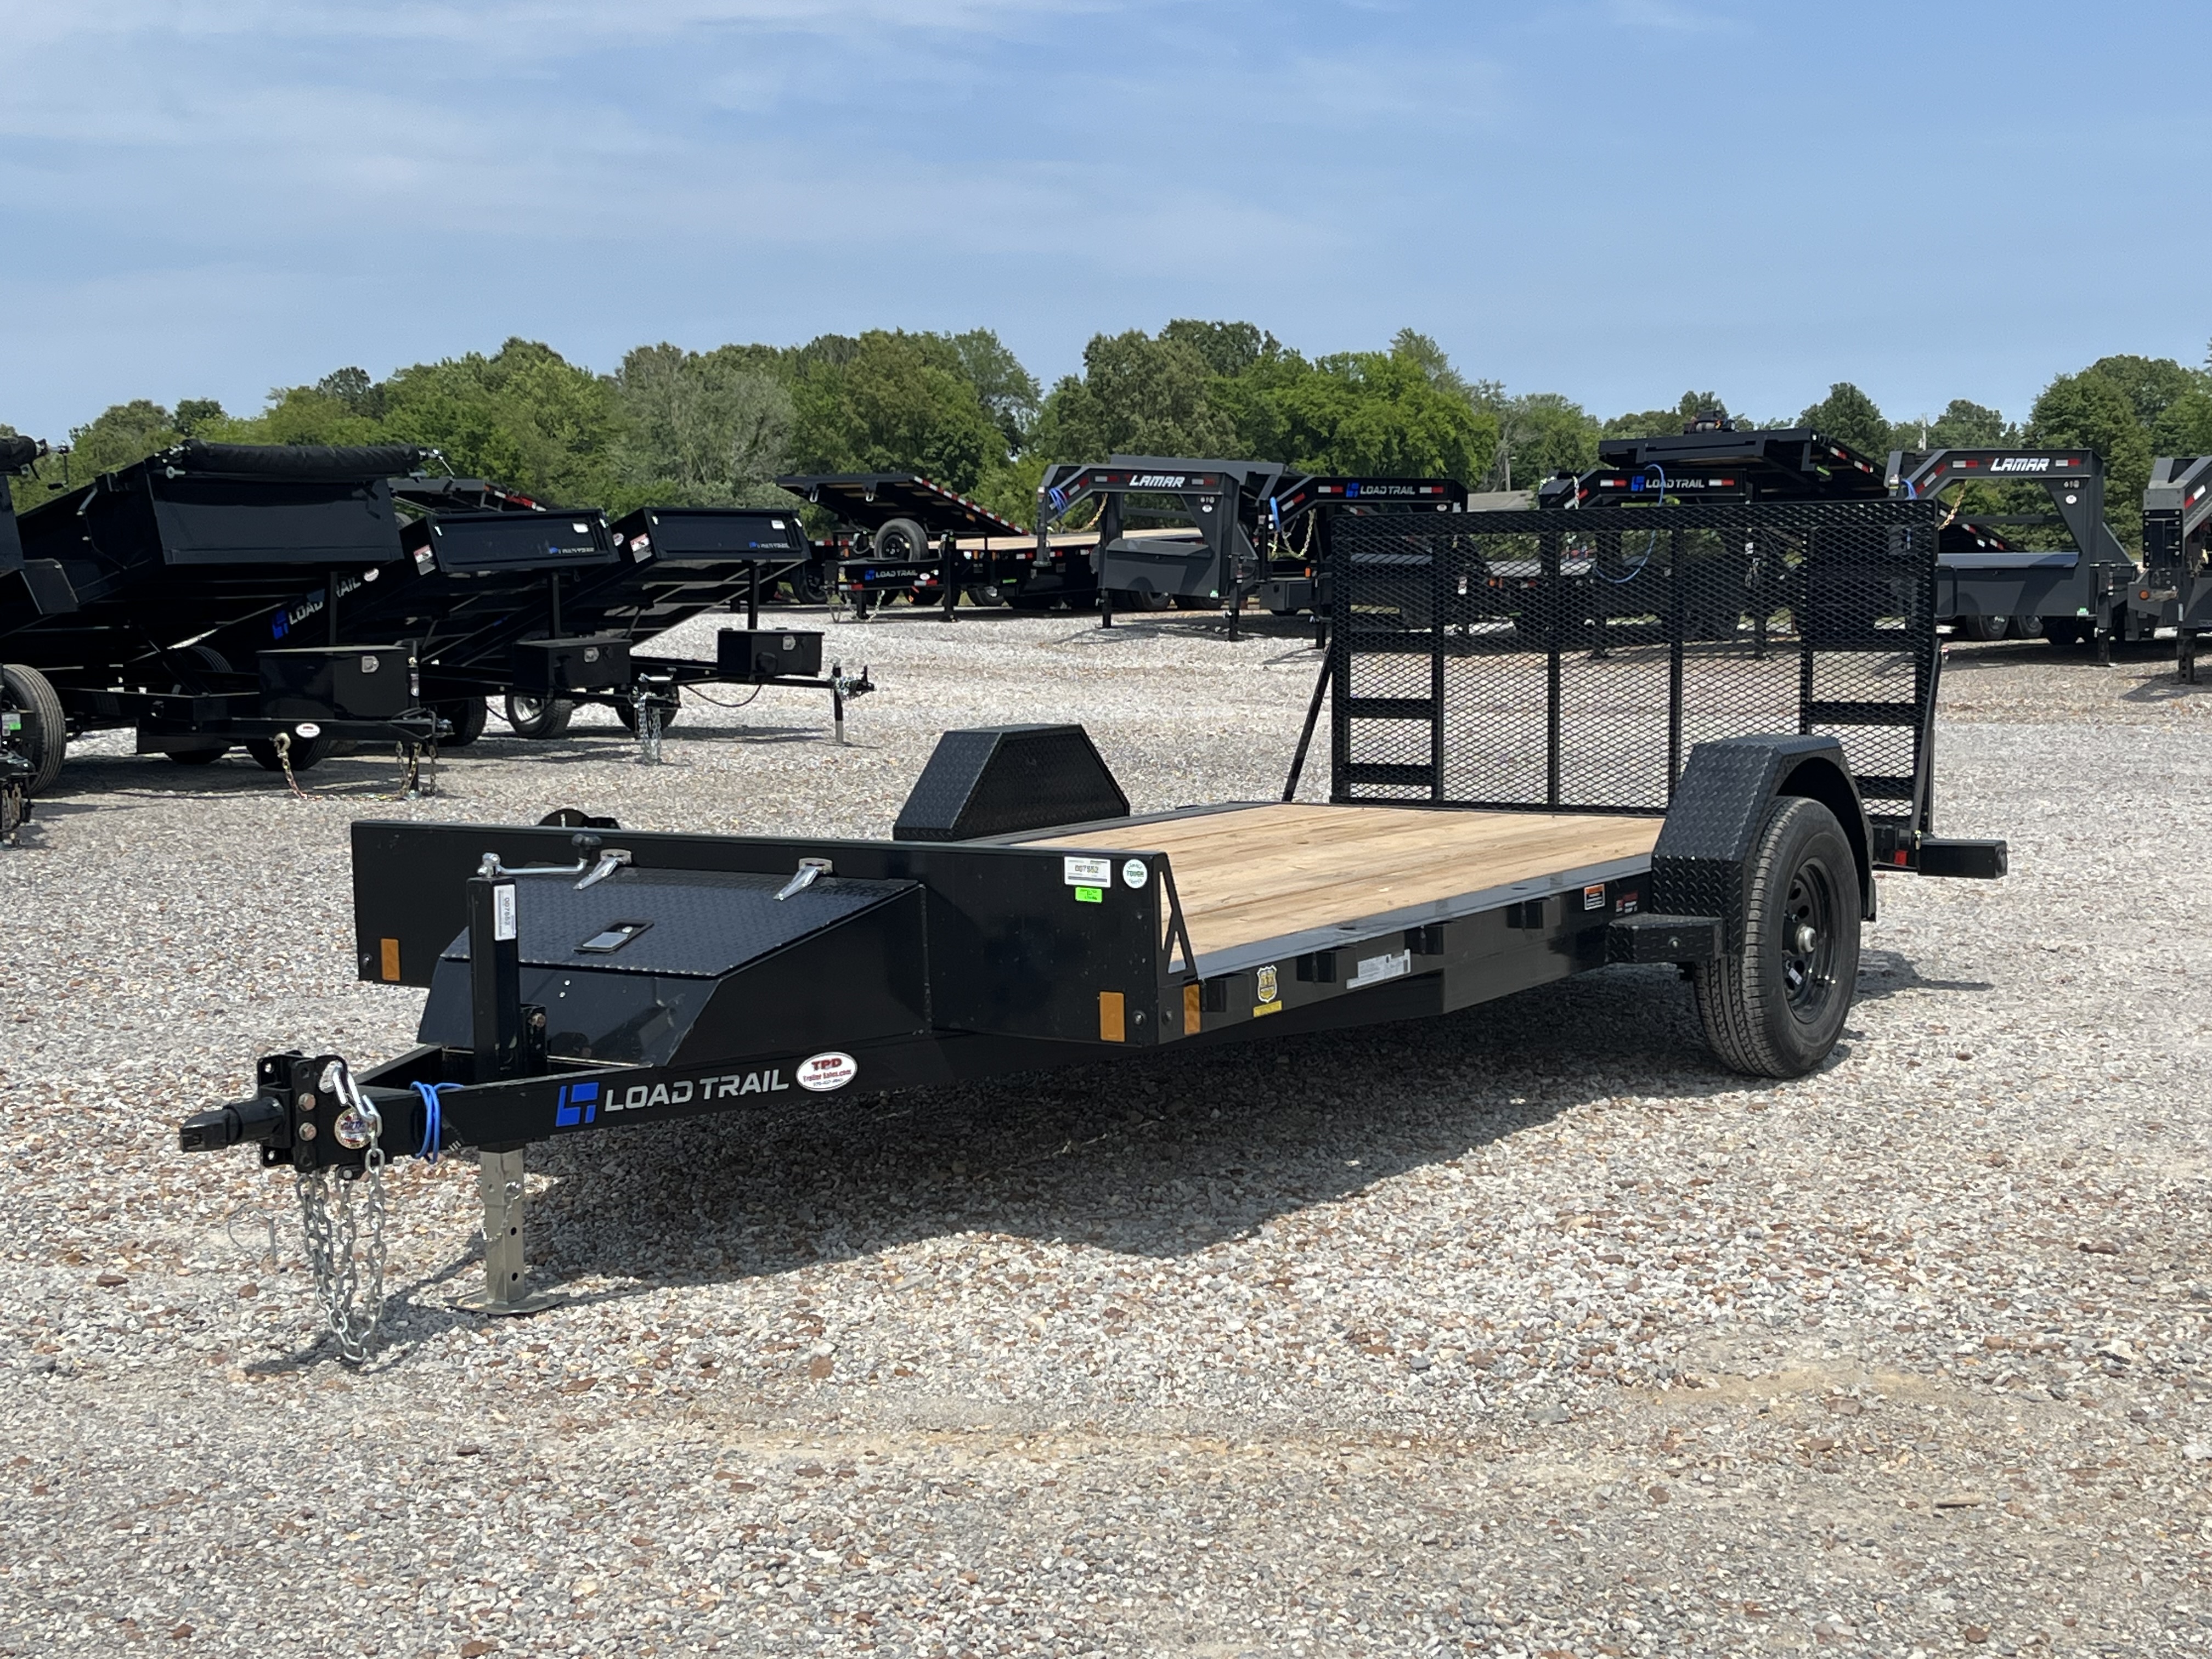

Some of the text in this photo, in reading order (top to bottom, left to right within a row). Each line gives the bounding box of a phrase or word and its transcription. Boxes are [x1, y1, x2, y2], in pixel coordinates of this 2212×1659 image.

[1990, 458, 2050, 471] LAMAR
[1129, 475, 1186, 488] LAMAR
[1646, 479, 1705, 488] LOAD TRAIL
[1360, 486, 1415, 494] LOAD TRAIL
[811, 1058, 843, 1071] TPD
[605, 1069, 789, 1112] LOAD TRAIL
